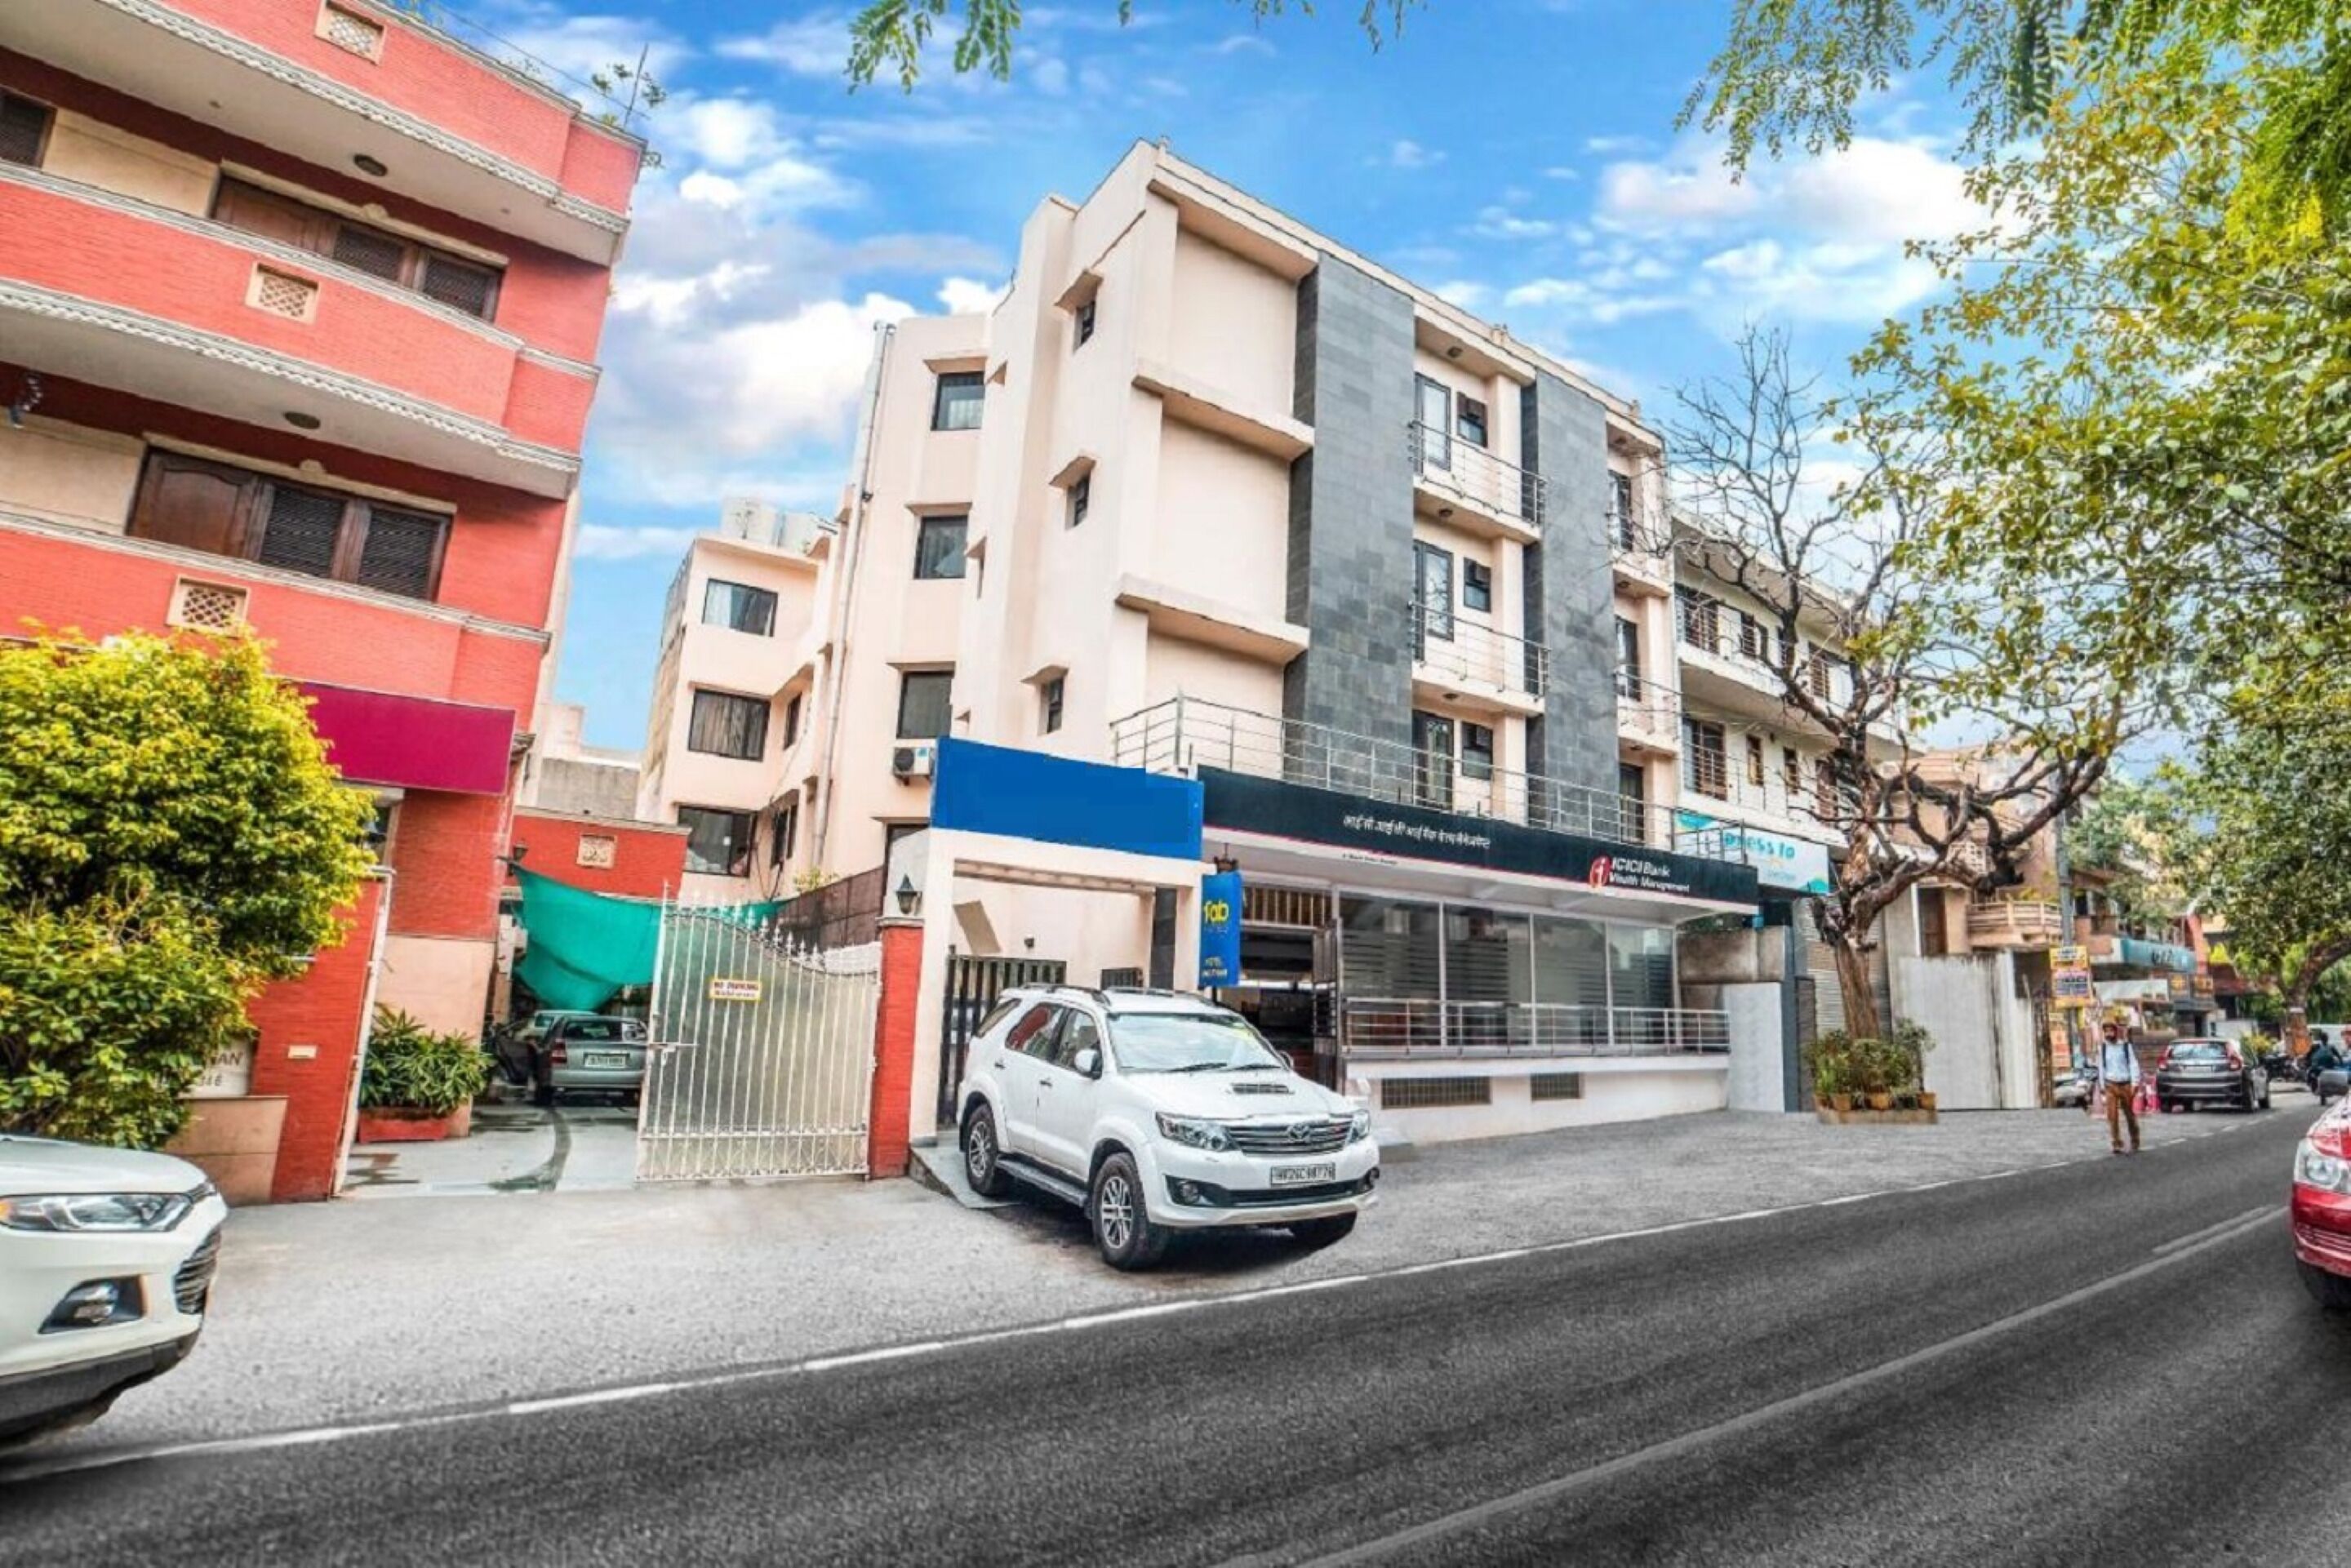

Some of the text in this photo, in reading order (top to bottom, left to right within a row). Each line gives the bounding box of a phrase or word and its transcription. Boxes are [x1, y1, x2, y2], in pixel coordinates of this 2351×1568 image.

[1612, 856, 1671, 878] ICICI Bank
[1640, 877, 1690, 893] Management
[1204, 900, 1229, 923] fab
